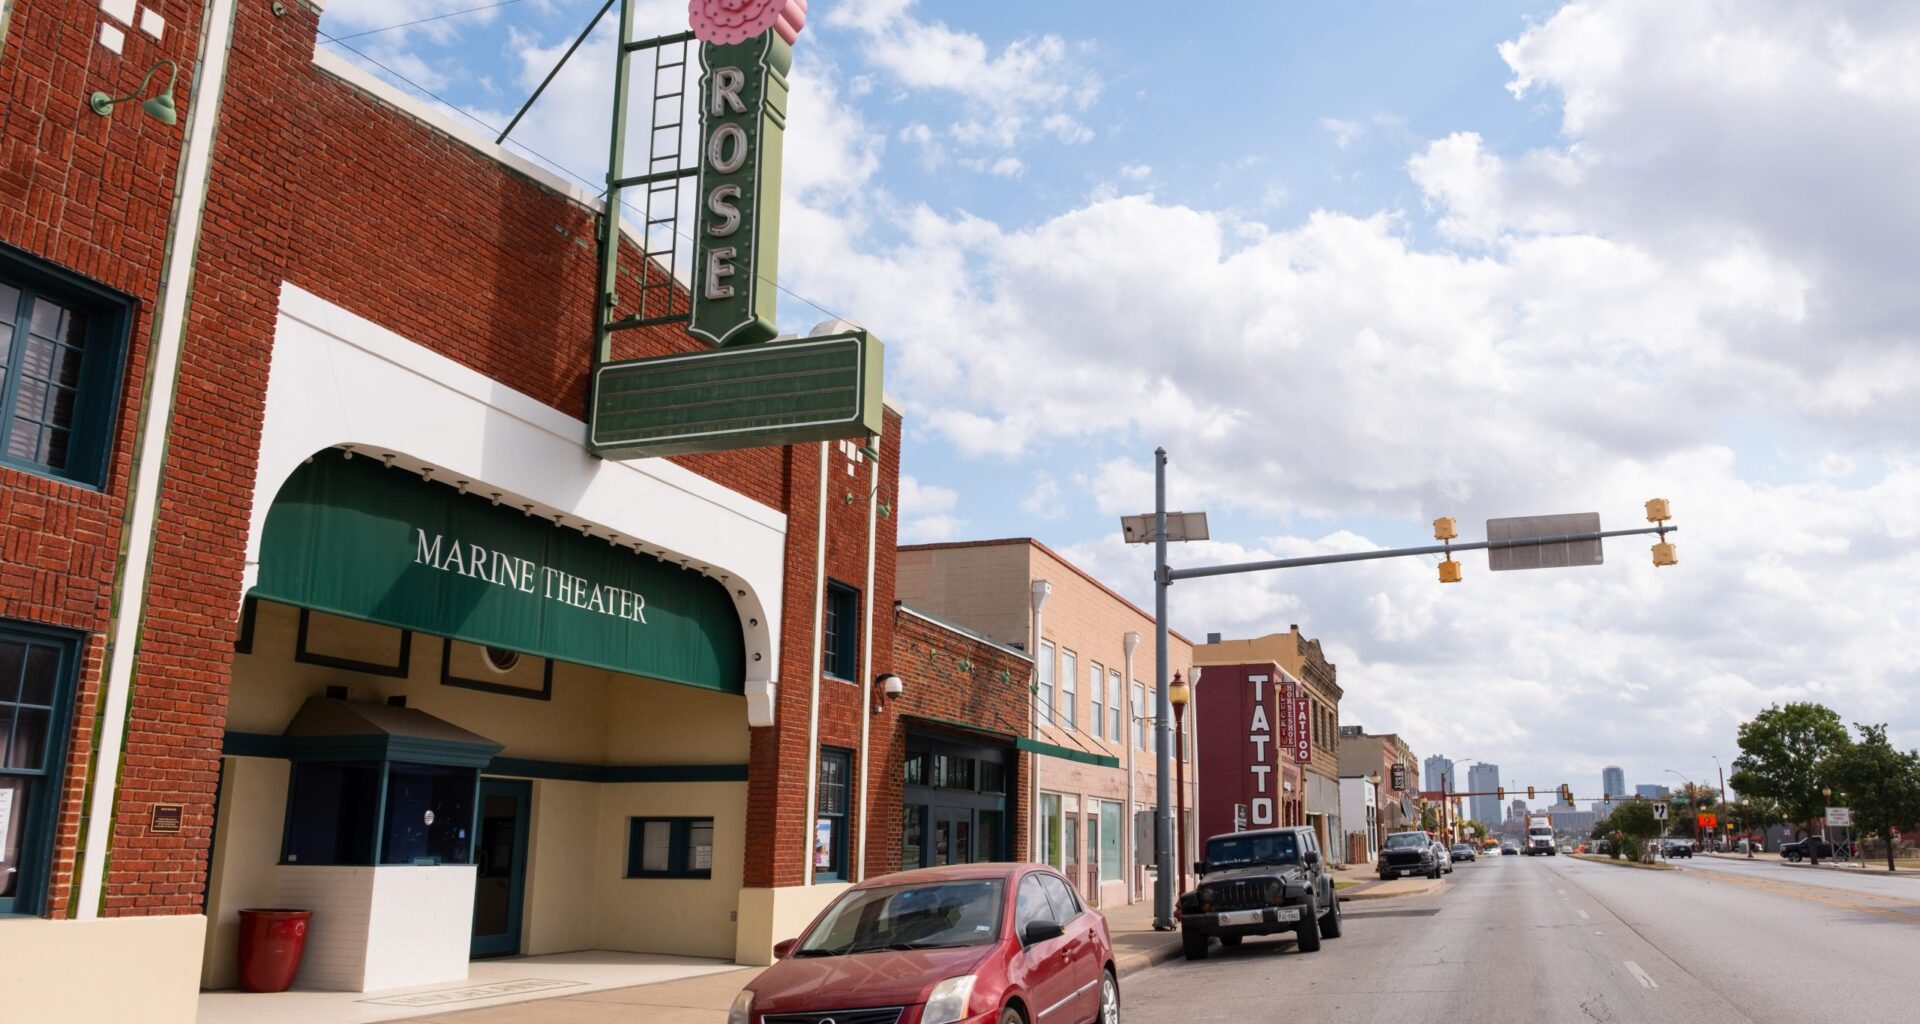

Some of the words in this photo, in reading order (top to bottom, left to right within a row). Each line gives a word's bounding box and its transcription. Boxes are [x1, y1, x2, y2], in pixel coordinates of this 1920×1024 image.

[705, 66, 747, 299] ROSE
[413, 527, 536, 594] MARINE
[541, 565, 648, 625] THEATER
[1248, 675, 1272, 825] TATTO
[1286, 684, 1294, 745] HORSESHOE
[1298, 701, 1308, 760] TATTOO
